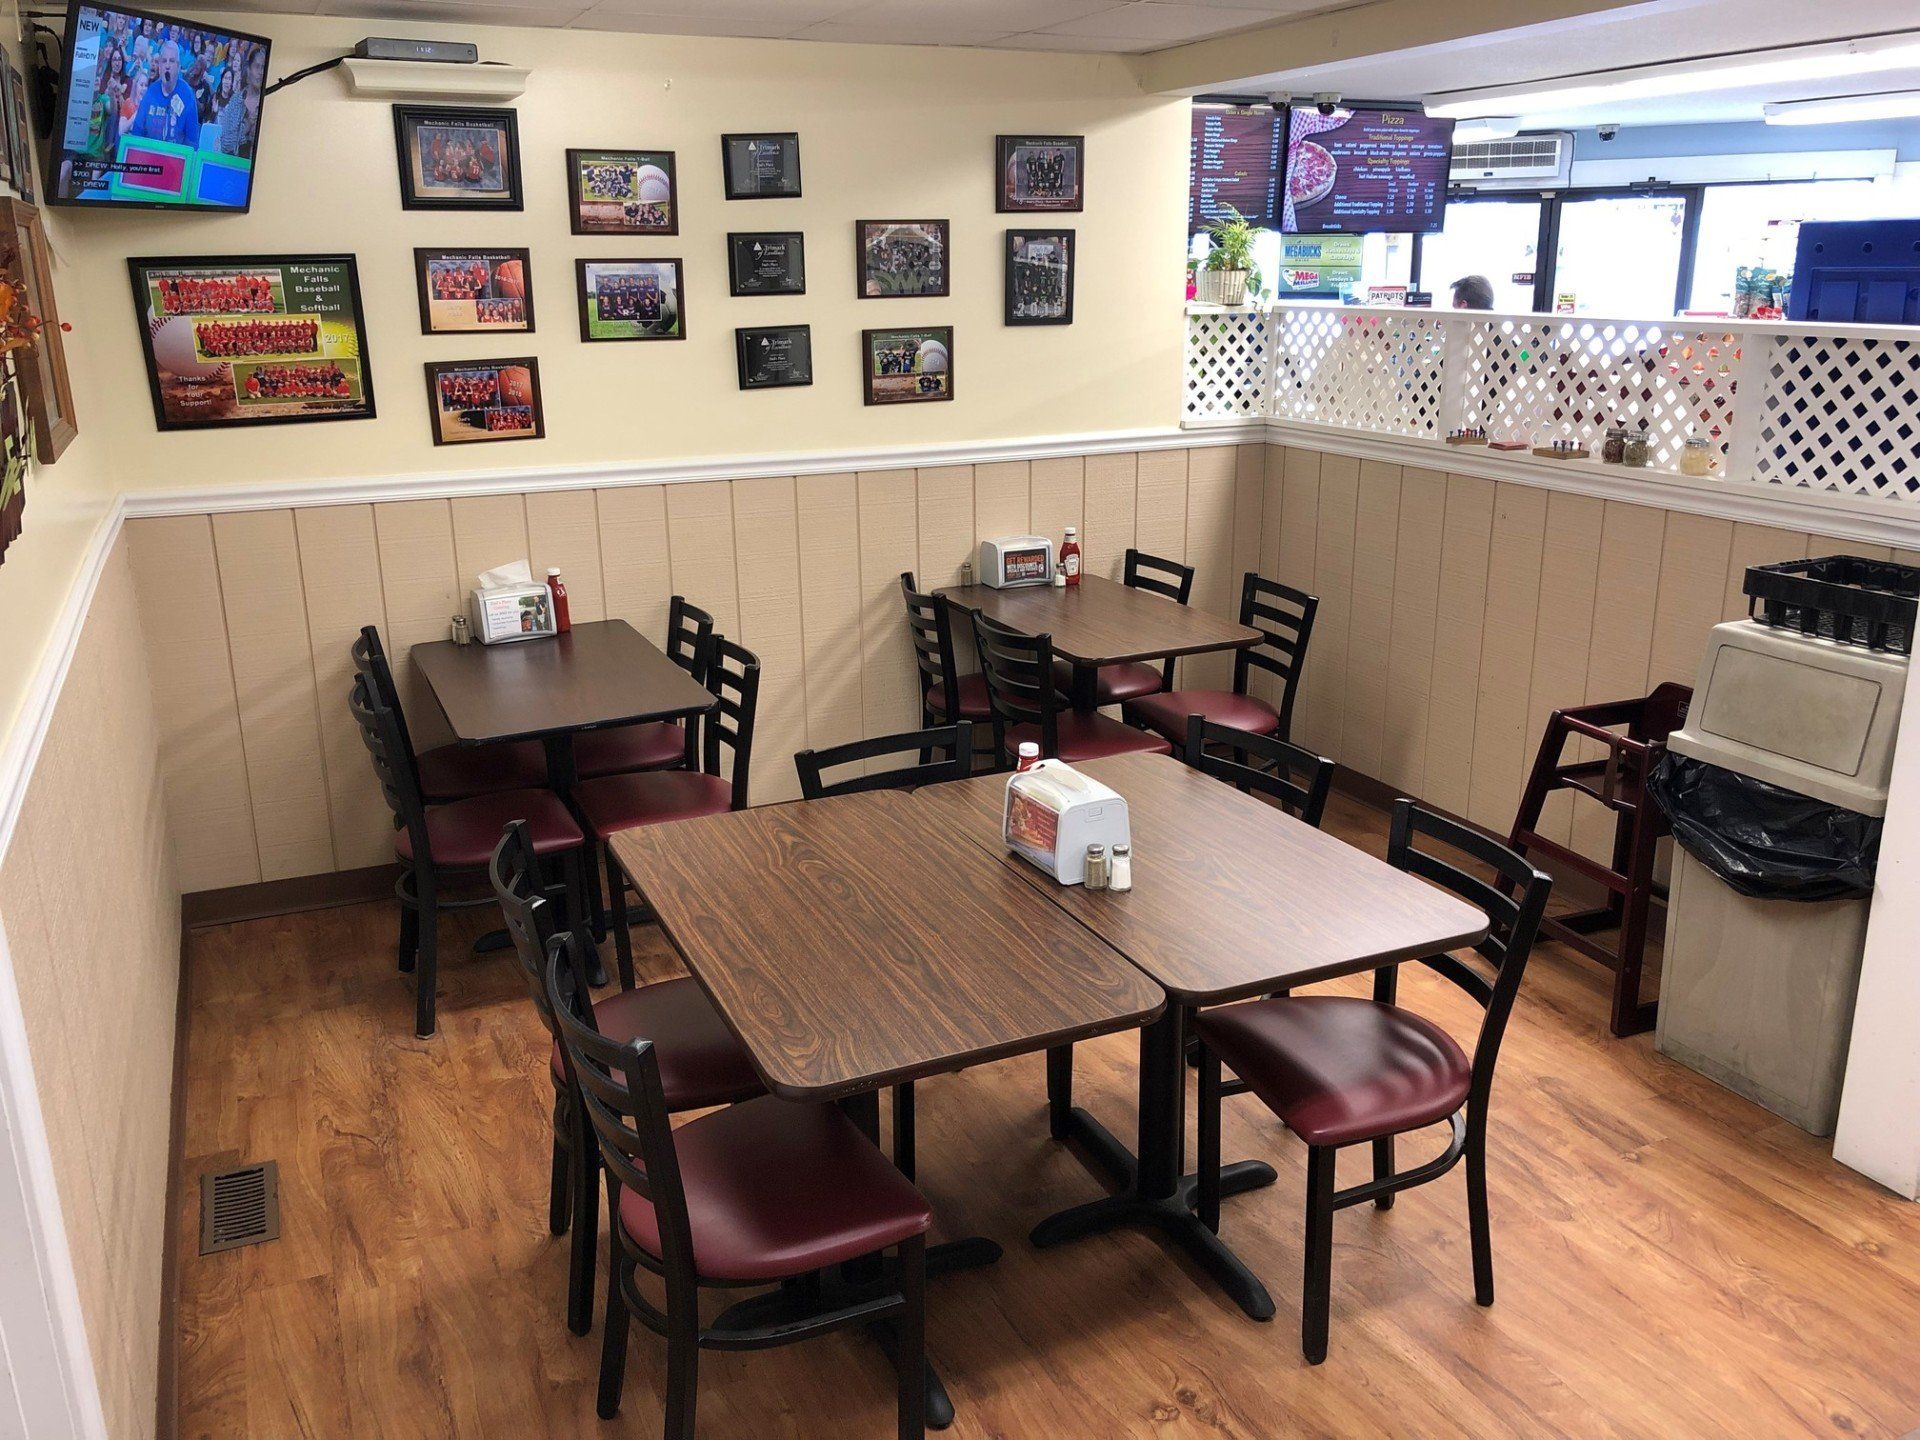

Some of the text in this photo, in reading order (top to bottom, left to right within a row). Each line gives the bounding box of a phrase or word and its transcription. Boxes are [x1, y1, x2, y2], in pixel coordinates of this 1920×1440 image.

[79, 19, 99, 32] NEW
[1382, 114, 1404, 125] Pizza
[1394, 134, 1414, 142] Toppings
[1285, 245, 1321, 258] MEGABUCKS
[290, 266, 340, 274] Mechanic
[1295, 271, 1318, 280] MEGA
[295, 285, 340, 293] Baseball
[1371, 292, 1404, 300] PATRIOTS
[300, 304, 340, 312] Softball
[326, 334, 350, 344] 2017
